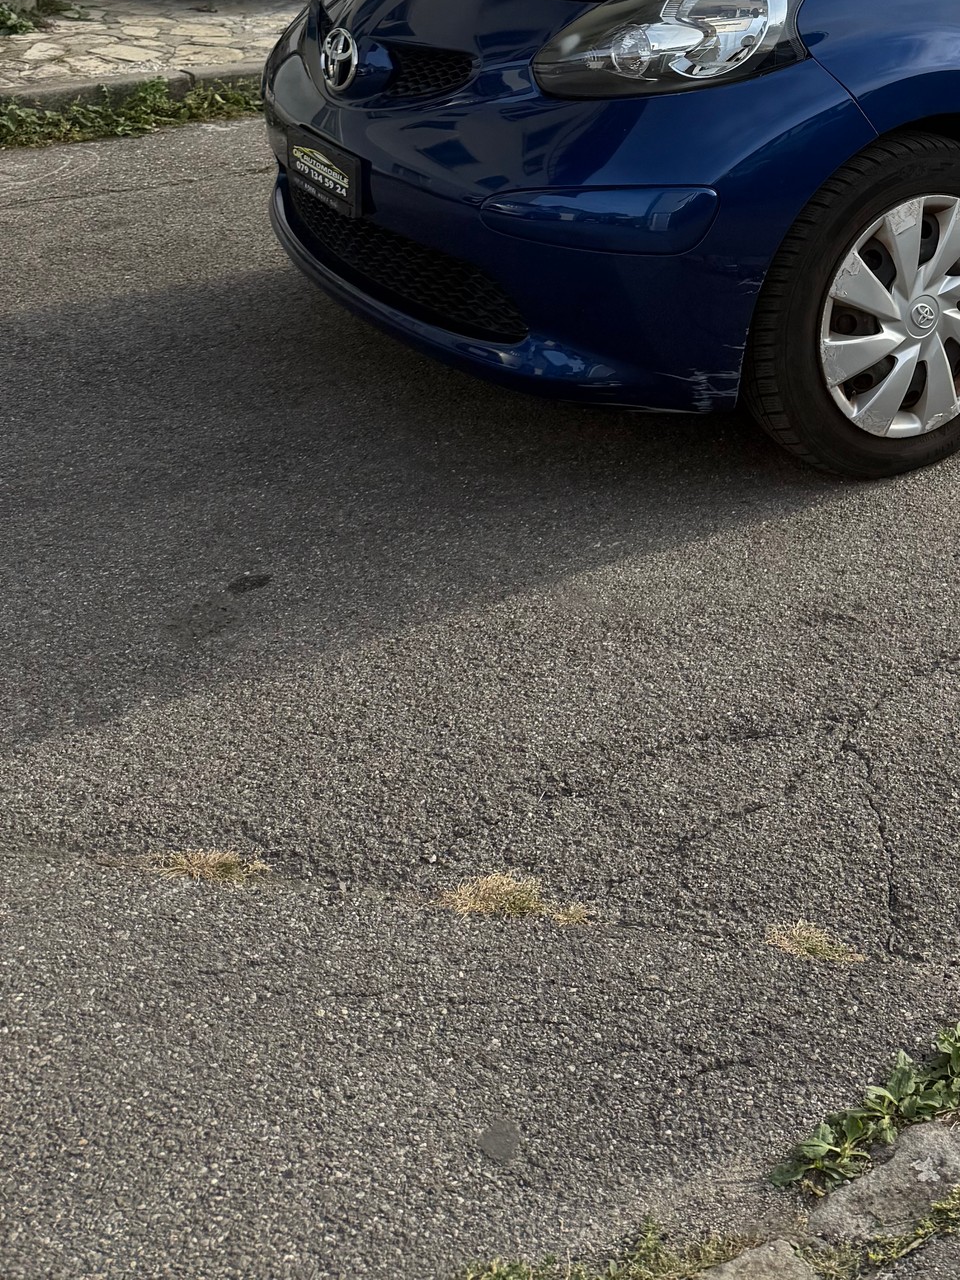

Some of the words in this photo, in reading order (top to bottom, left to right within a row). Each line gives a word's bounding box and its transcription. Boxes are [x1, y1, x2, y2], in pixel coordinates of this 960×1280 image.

[296, 160, 310, 174] 079
[310, 169, 324, 183] 134
[324, 177, 335, 189] 59
[335, 184, 347, 197] 24
